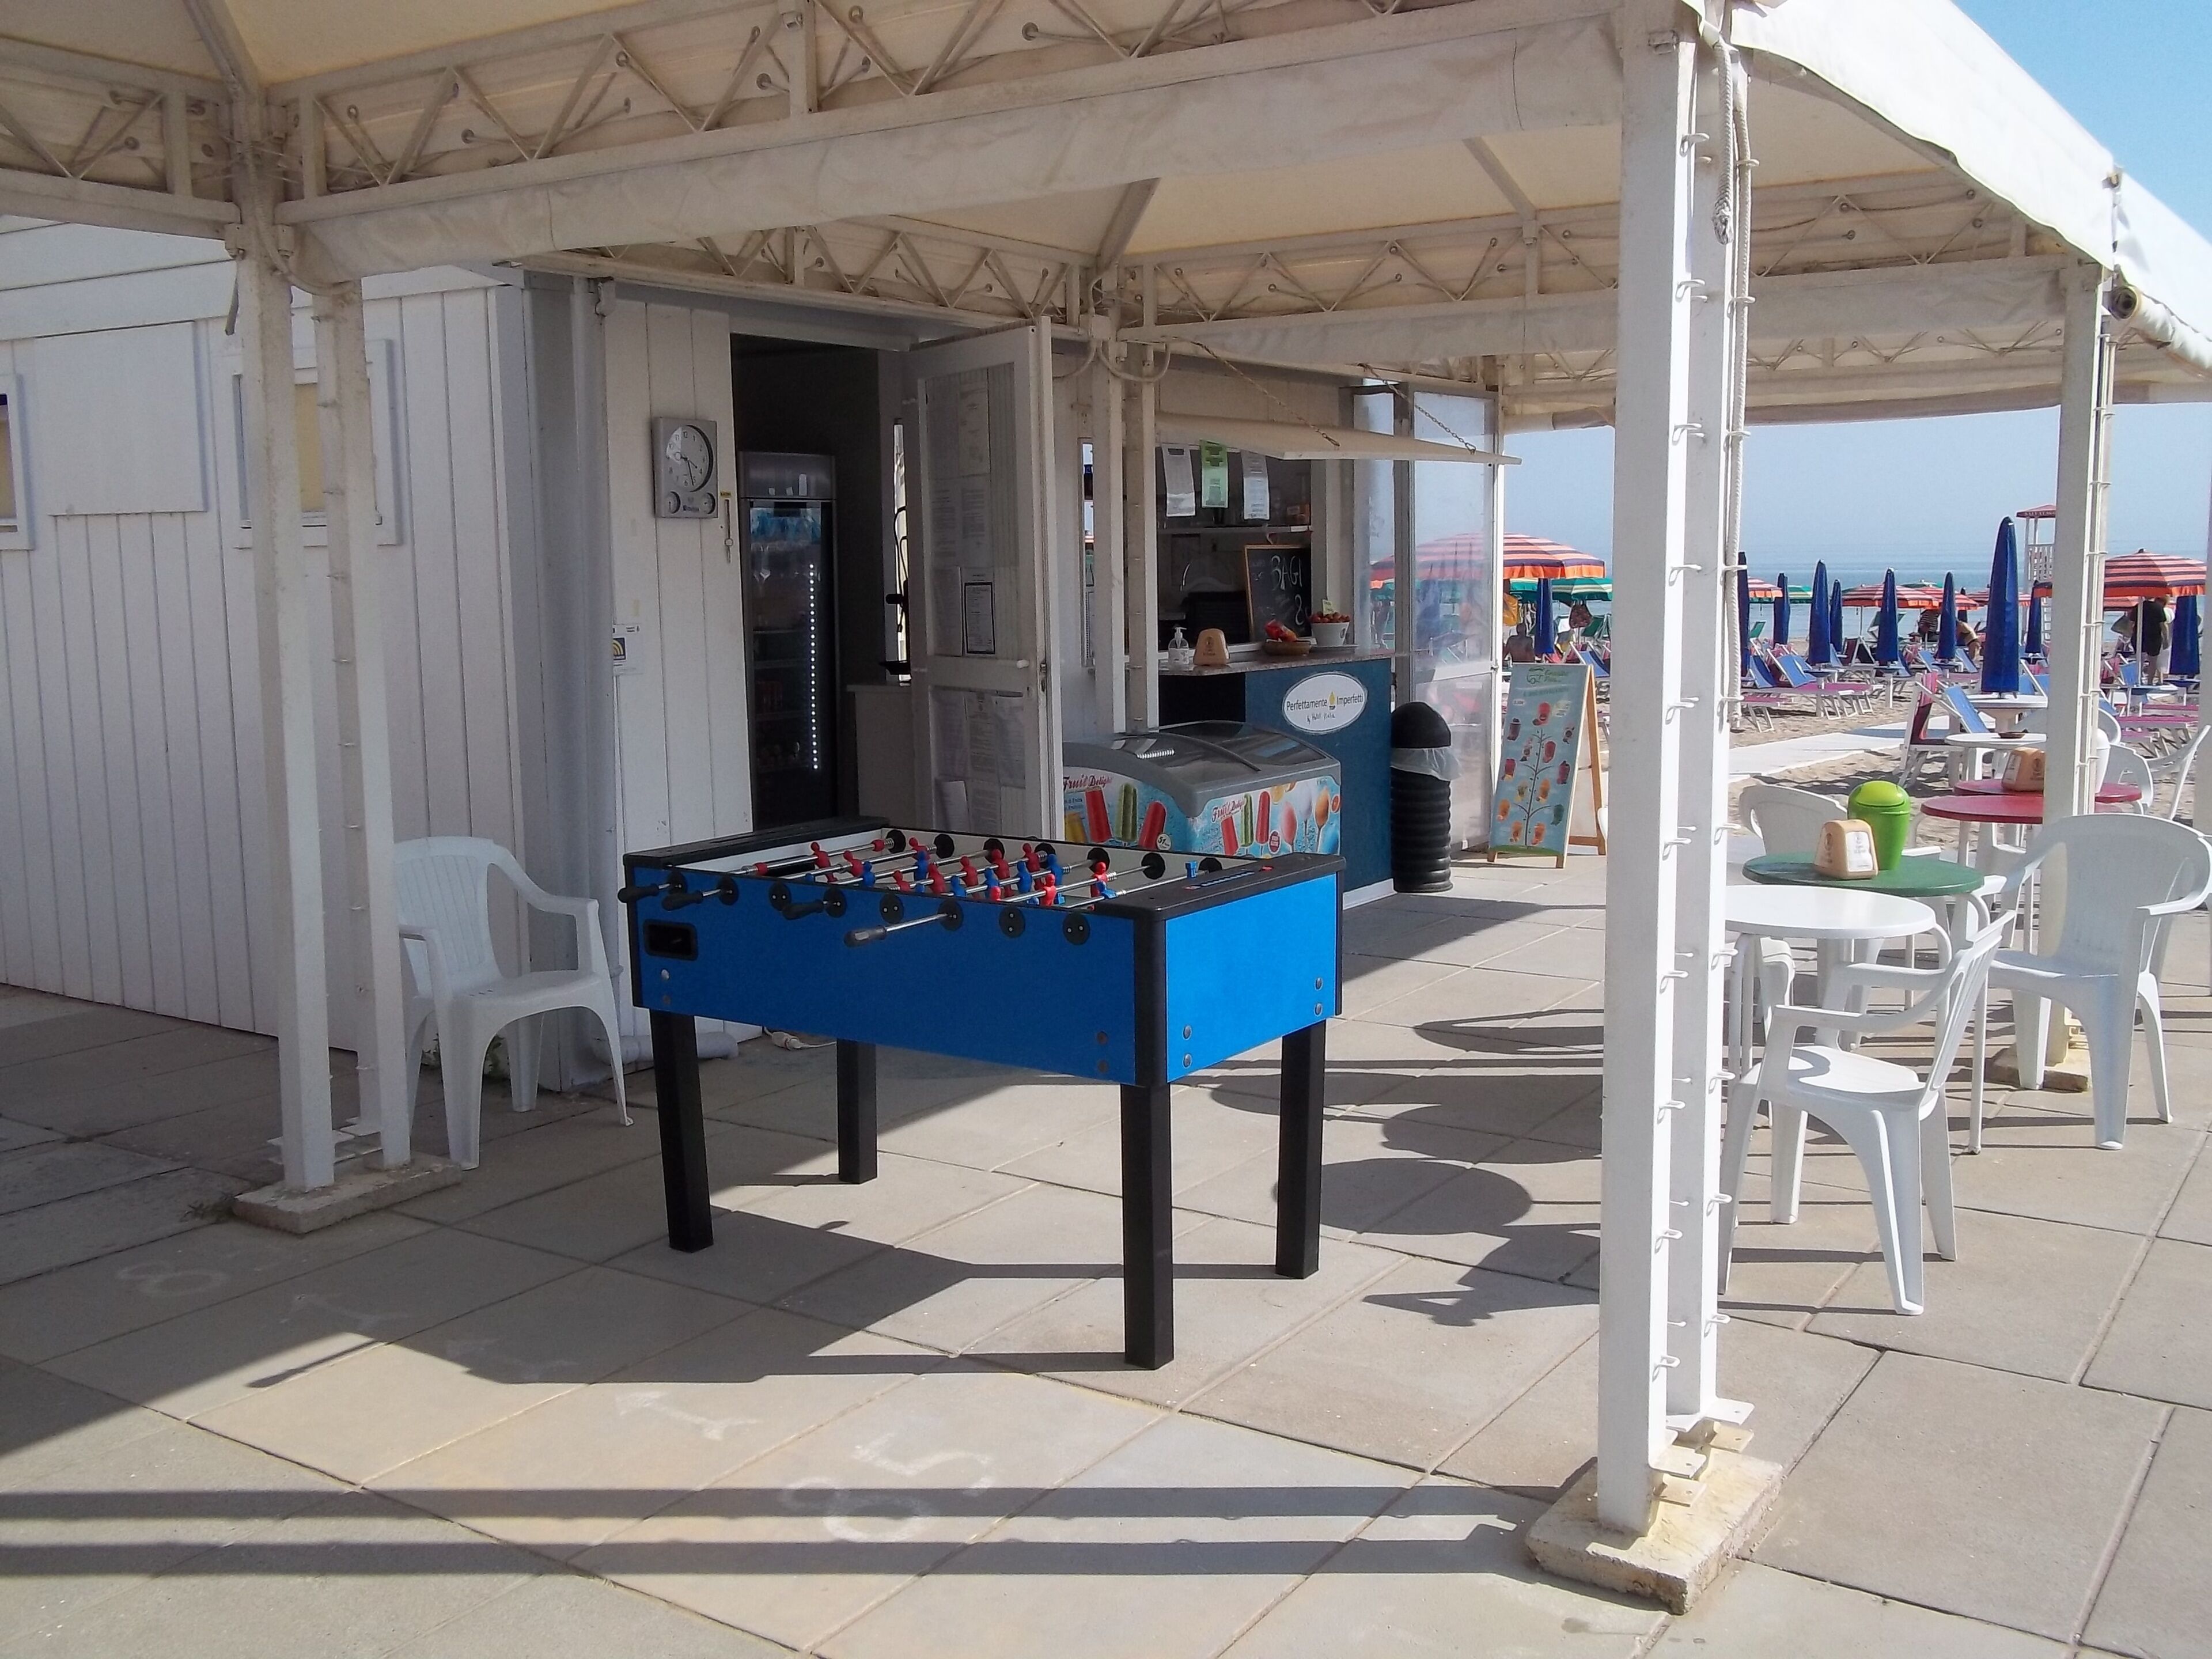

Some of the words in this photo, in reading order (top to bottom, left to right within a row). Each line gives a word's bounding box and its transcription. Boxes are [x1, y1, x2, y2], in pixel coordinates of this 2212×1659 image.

[1286, 699, 1328, 711] Perfettamente
[1336, 693, 1363, 707] Imperfetti
[1212, 801, 1230, 822] Fruit
